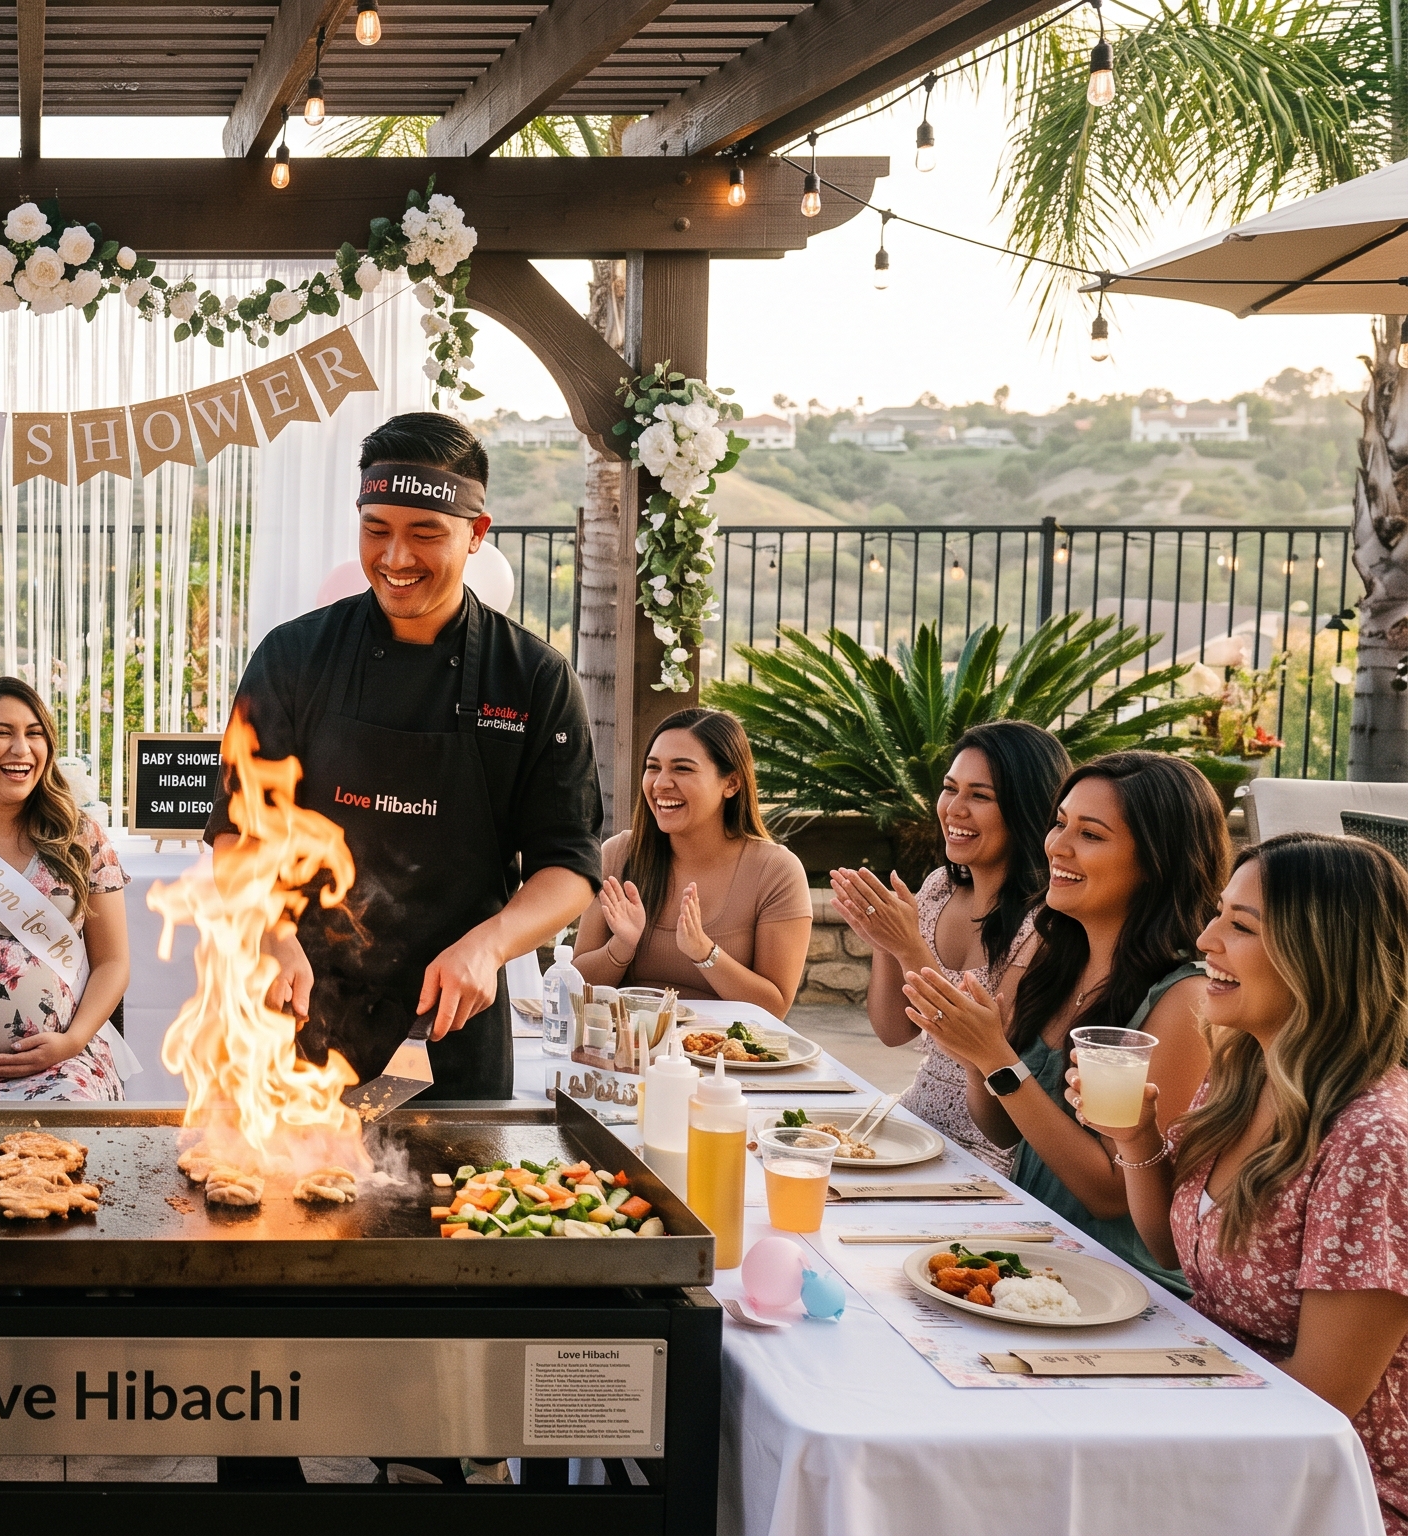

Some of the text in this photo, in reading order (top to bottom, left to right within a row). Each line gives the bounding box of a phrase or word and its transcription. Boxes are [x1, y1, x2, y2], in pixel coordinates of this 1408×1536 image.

[25, 344, 363, 464] SHOWER
[391, 475, 457, 503] Hibachi
[142, 753, 173, 765] BABY
[159, 775, 206, 787] HIBACHI
[150, 801, 214, 813] SAN DIEGO
[334, 786, 437, 816] Love Hibachi
[557, 1350, 620, 1359] Love Hibachi
[75, 1370, 302, 1421] Hibachi
